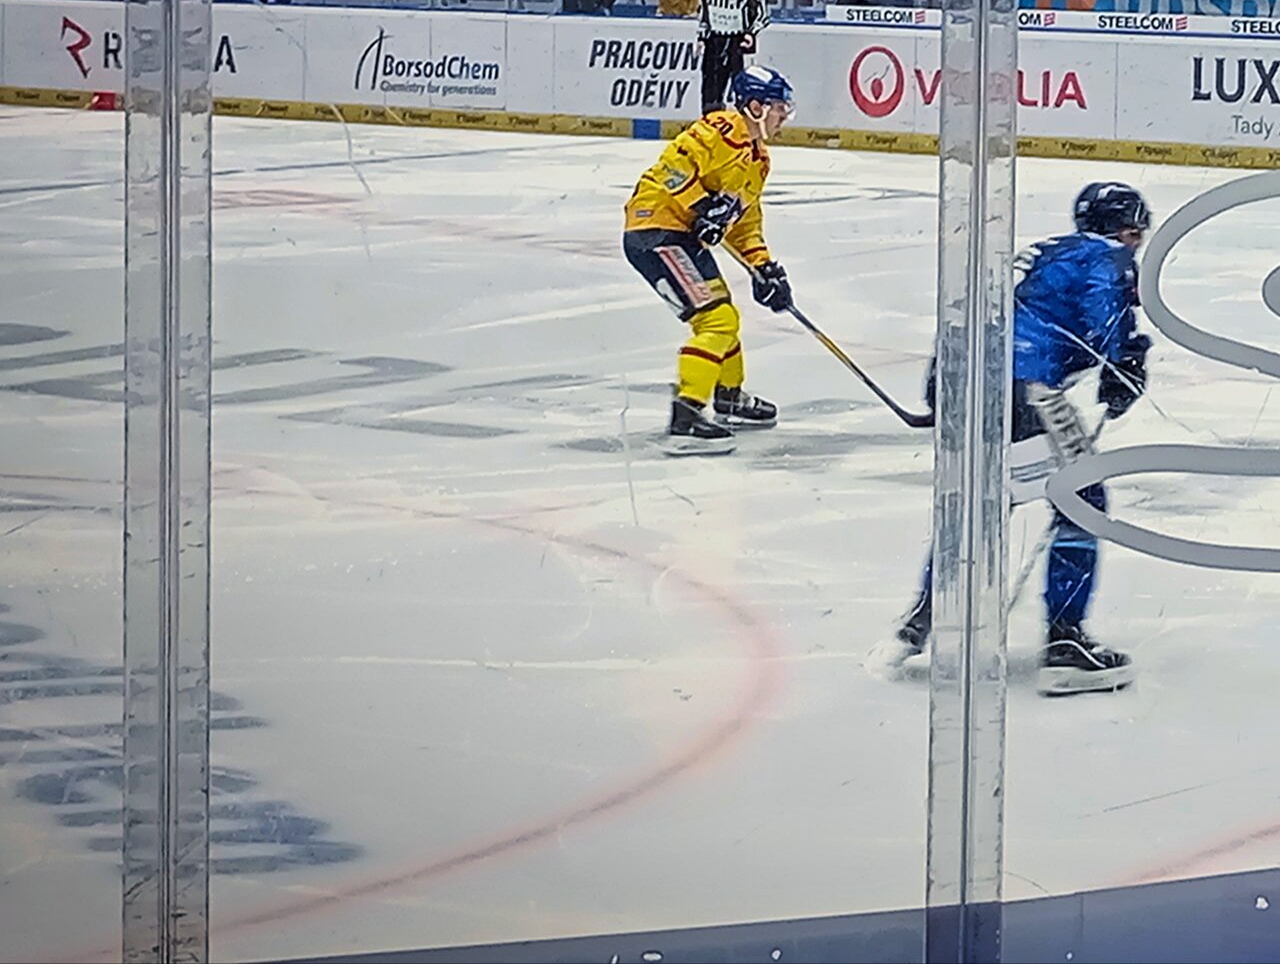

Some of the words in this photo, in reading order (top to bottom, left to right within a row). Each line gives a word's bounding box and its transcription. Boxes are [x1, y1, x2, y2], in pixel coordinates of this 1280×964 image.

[846, 8, 913, 25] STEELCOM
[1097, 14, 1175, 31] STEELCOM
[381, 54, 500, 80] BorsodChem
[588, 39, 700, 71] PRACOVN
[441, 84, 498, 97] generations
[610, 72, 691, 109] ODĚVY
[914, 68, 1088, 110] VLIA
[710, 115, 734, 137] 20
[1231, 114, 1275, 140] Tady
